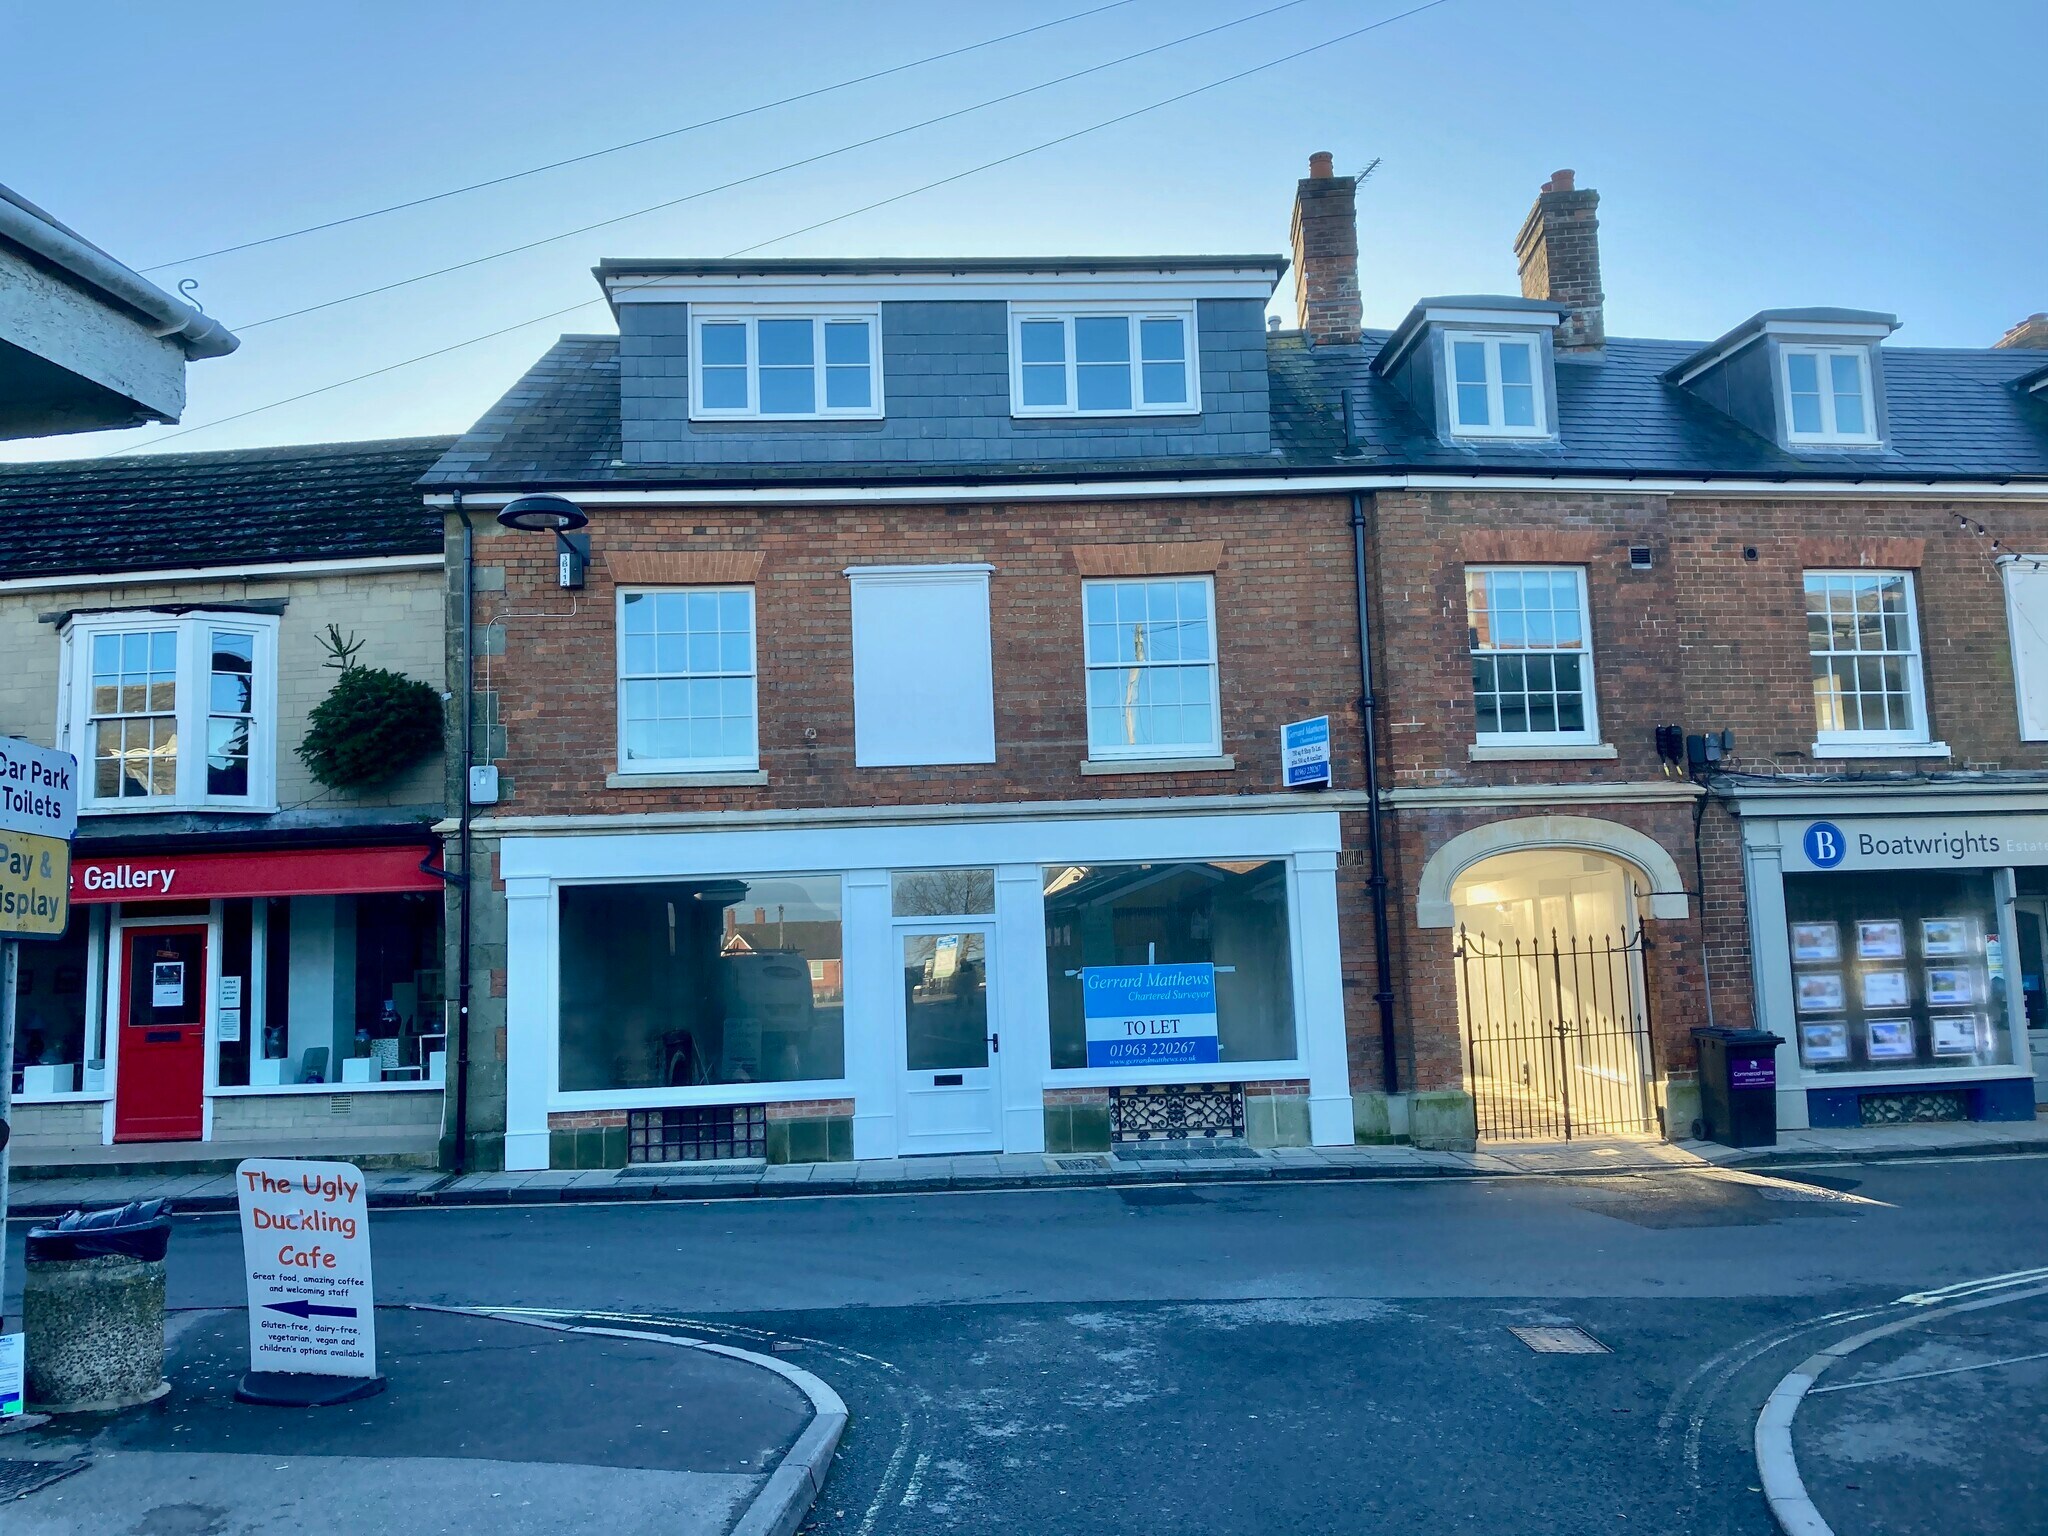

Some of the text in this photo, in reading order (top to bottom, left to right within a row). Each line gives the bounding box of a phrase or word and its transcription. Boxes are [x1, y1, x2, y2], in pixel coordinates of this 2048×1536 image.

[0, 752, 70, 790] Car Park
[3, 786, 61, 819] Toilets
[1815, 831, 1836, 859] B
[1859, 830, 2000, 860] Boatwrights
[40, 850, 52, 878] &
[84, 865, 175, 893] Gallery
[0, 884, 59, 923] isplay
[1088, 972, 1209, 989] Gerrard Matthews
[1128, 989, 1210, 1001] Chartered Surveyor
[1124, 1019, 1180, 1035] TO LET
[1110, 1042, 1196, 1057] 01963 220267
[242, 1170, 358, 1203] The Ugly
[253, 1207, 356, 1239] Duckling
[278, 1246, 336, 1269] Cafe
[253, 1272, 275, 1281] Great
[303, 1276, 334, 1286] amazing
[338, 1276, 364, 1286] coffee
[269, 1285, 349, 1297] and welcoming staff
[261, 1321, 361, 1335] Gluten-free, dairy-free,
[268, 1332, 355, 1346] vegetarian, vegan and
[259, 1344, 364, 1358] children's options available
